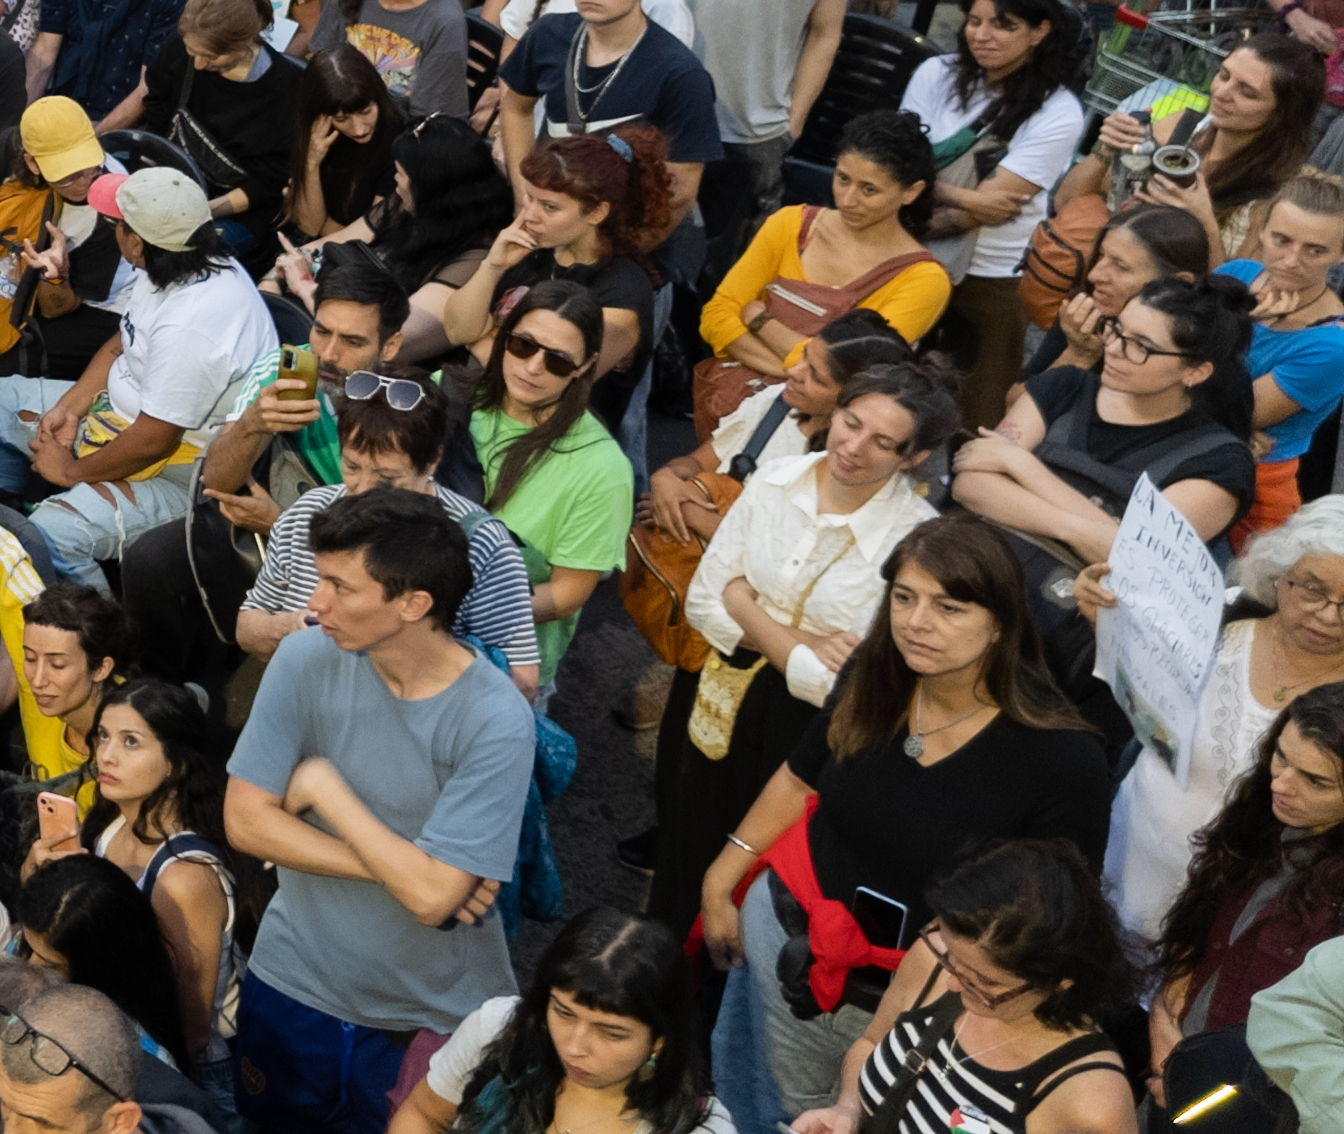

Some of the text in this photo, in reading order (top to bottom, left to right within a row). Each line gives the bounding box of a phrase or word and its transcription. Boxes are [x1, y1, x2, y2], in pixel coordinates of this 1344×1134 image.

[1133, 478, 1218, 589] LA MEJOR
[1118, 575, 1138, 611] OS
